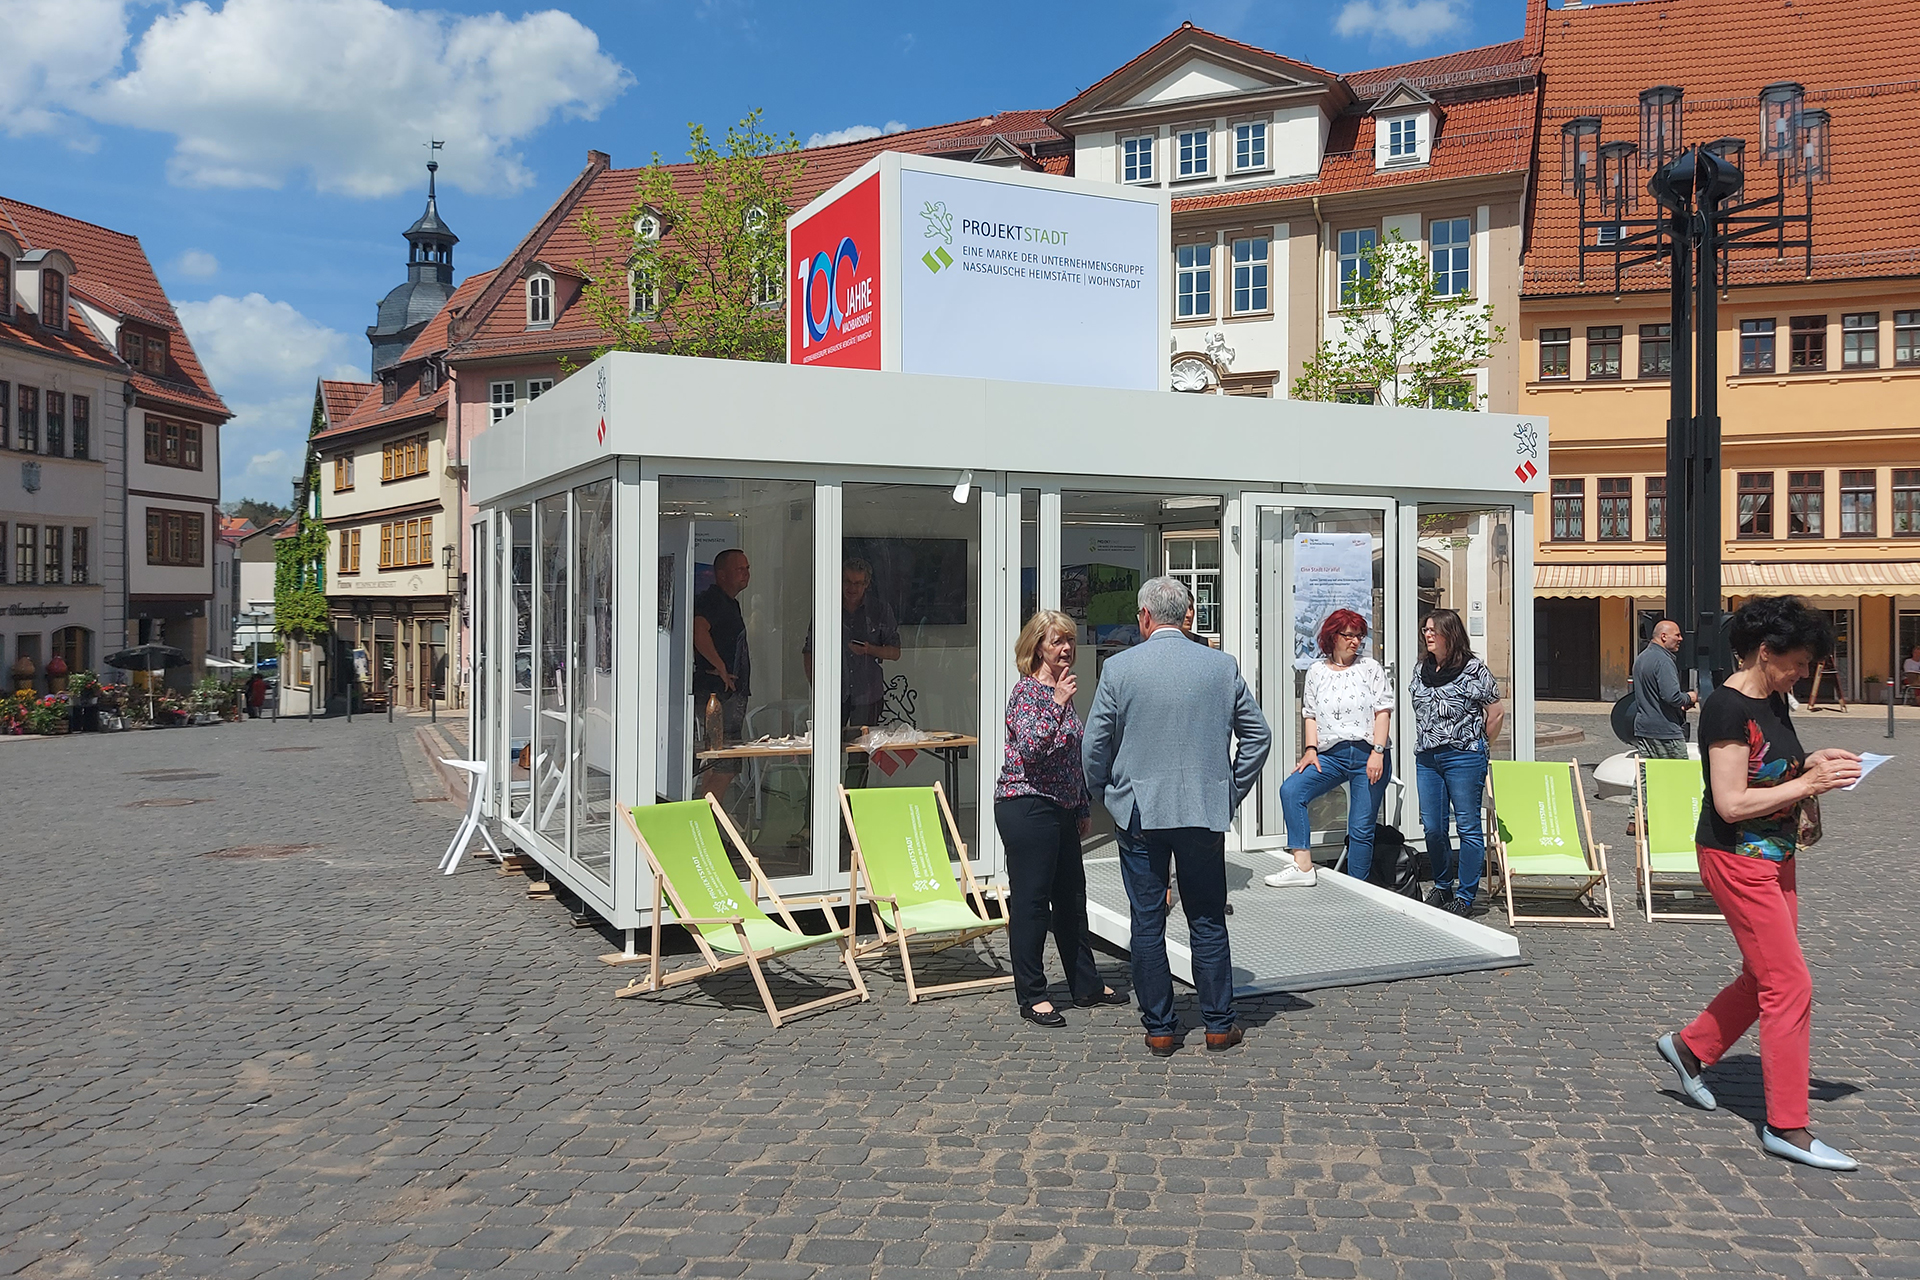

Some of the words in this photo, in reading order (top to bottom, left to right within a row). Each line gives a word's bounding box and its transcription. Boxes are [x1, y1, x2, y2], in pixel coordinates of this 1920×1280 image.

[962, 218, 1069, 246] PROJEKTSTADT
[962, 245, 984, 258] EINE
[986, 248, 1018, 262] MARKE
[1021, 252, 1039, 264] DER
[1041, 254, 1145, 276] UNTERNEHMENSGRUPPE
[962, 261, 1026, 278] NASSAUISCHE
[1028, 268, 1081, 284] HEIMSTÄTTE
[1088, 275, 1141, 289] WOHNSTADT
[845, 277, 872, 318] JAHRE
[905, 836, 921, 878] PROJEKTSTADT
[692, 855, 718, 899] PROJEKTSTADT
